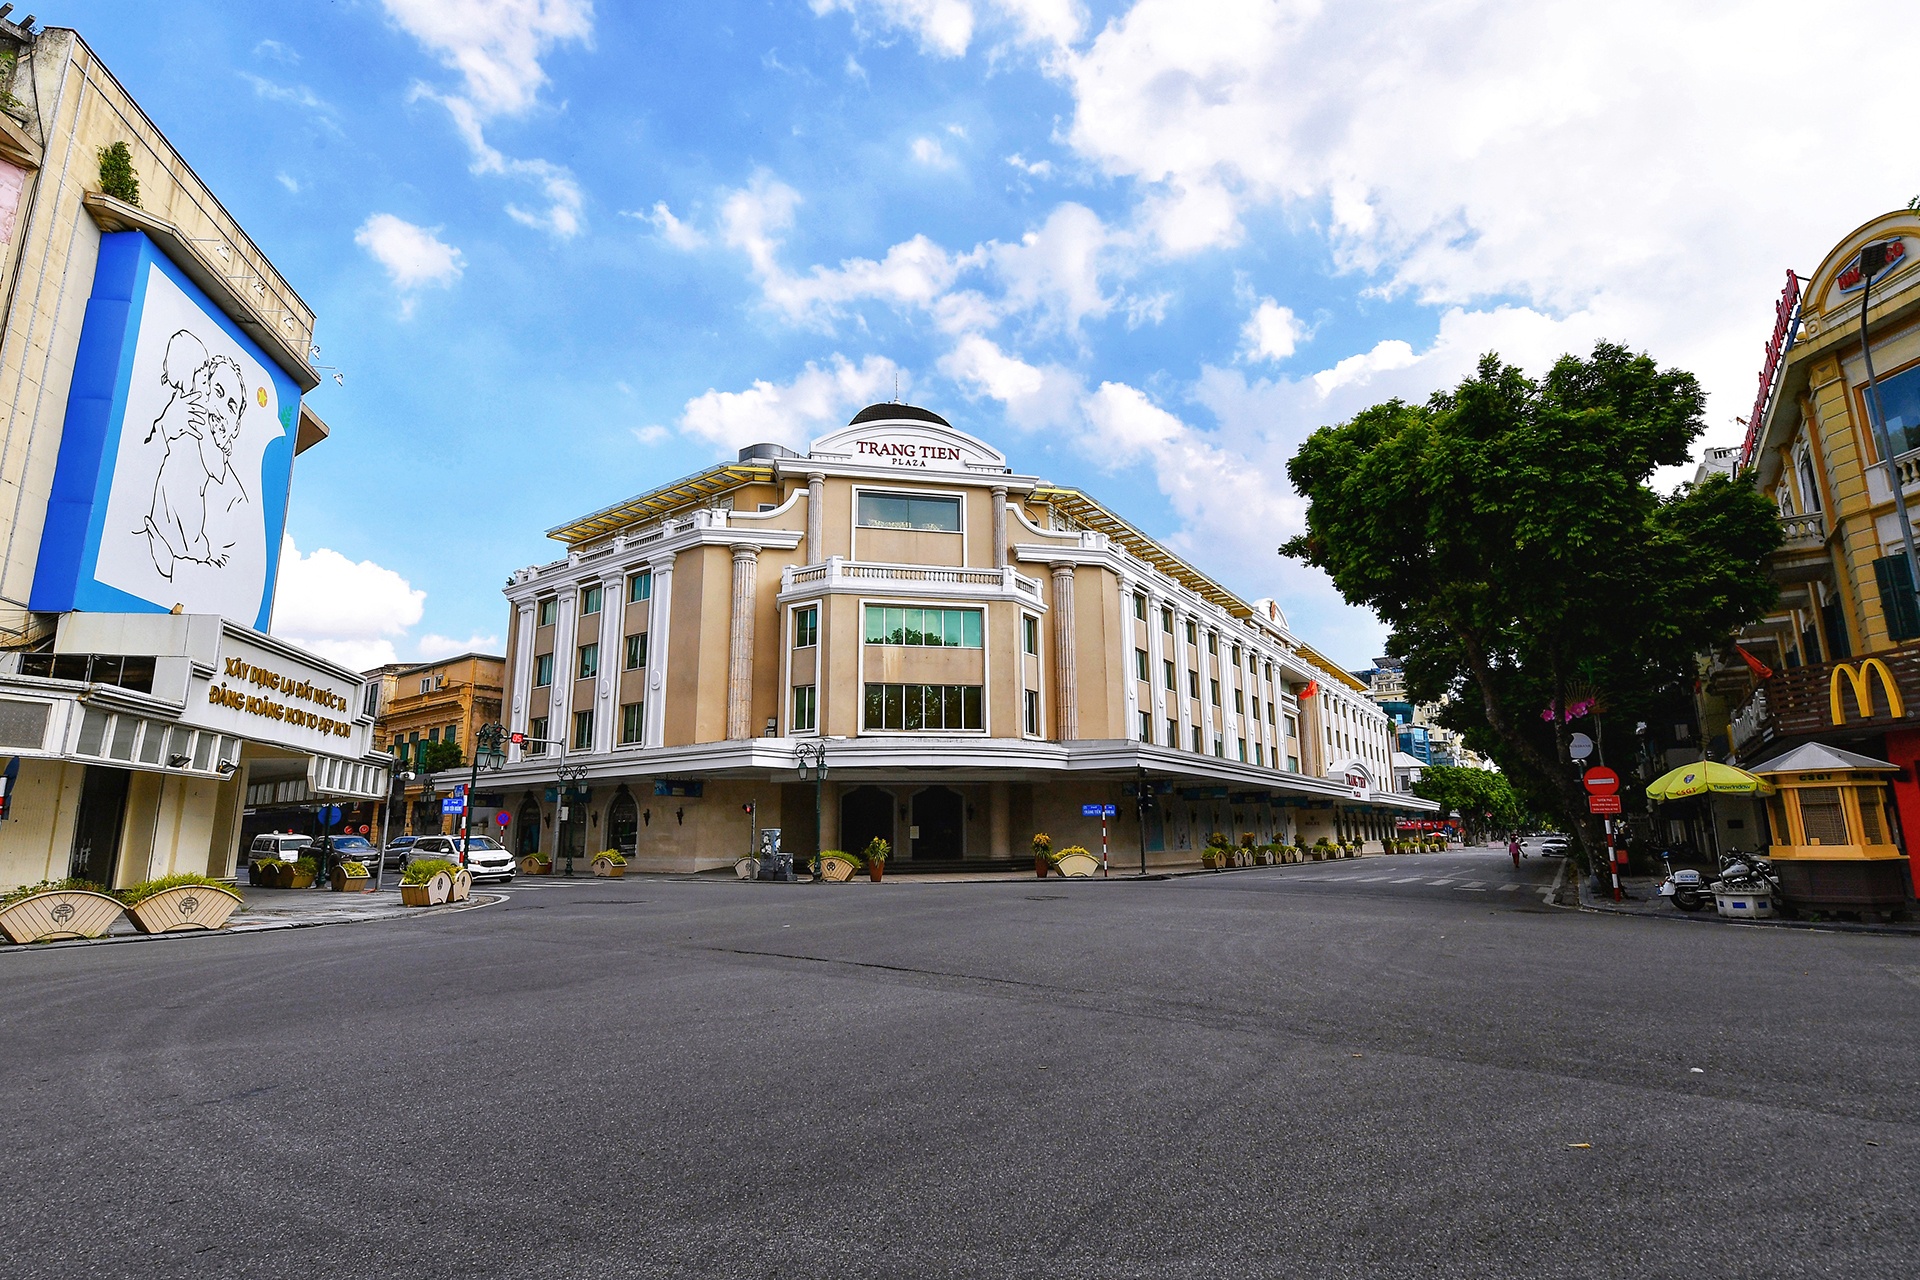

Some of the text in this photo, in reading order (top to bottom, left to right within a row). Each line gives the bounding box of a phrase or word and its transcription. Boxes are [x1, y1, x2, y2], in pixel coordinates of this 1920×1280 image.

[856, 441, 960, 460] TRANG TIEN
[892, 458, 926, 467] PLAZA
[280, 677, 296, 698] LẠI
[337, 697, 347, 712] TA
[306, 713, 318, 729] TO
[1799, 773, 1832, 781] CSGT
[1675, 787, 1697, 796] CSGT
